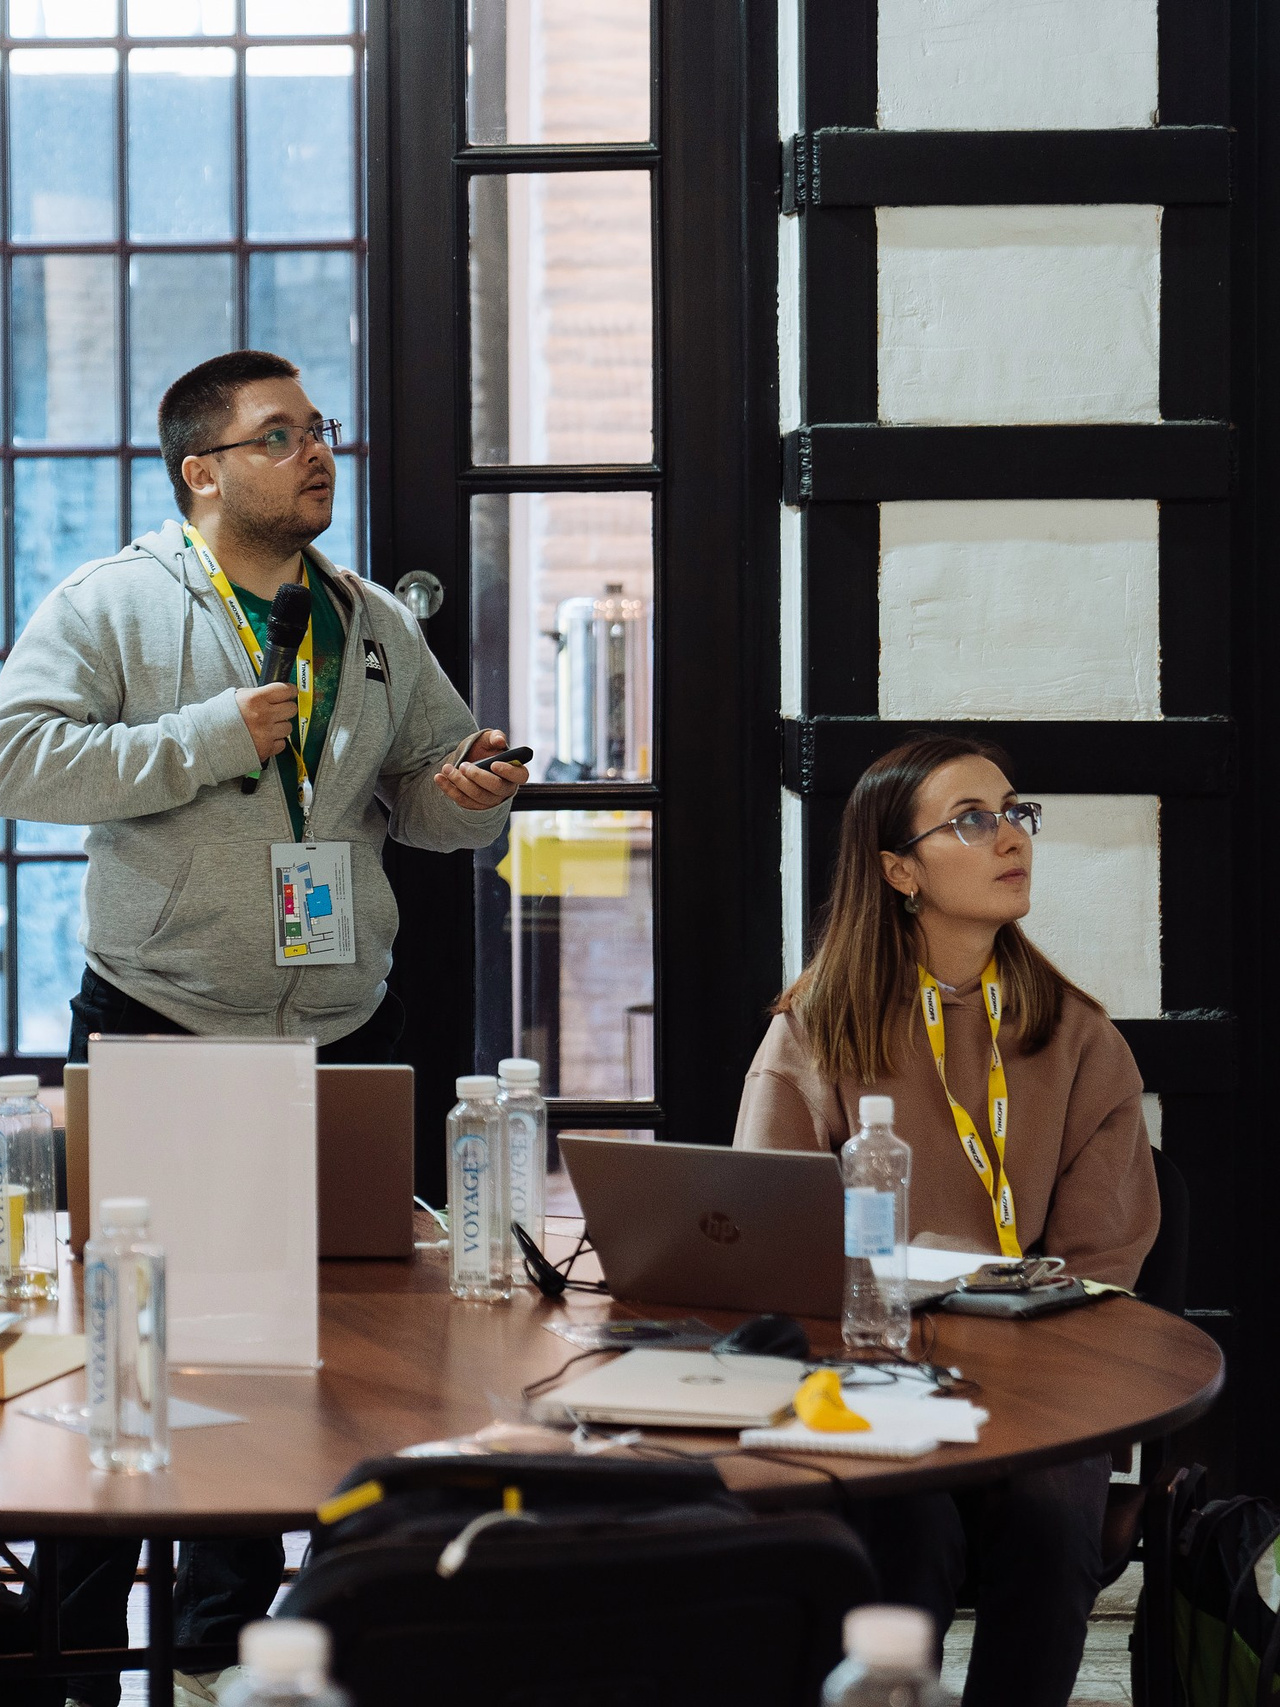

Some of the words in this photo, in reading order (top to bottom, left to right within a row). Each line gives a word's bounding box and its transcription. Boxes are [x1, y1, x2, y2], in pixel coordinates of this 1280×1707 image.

[202, 549, 216, 573] TINKOFF
[228, 599, 244, 626] TINKOFF
[926, 990, 936, 1021] TINKOFF
[990, 986, 998, 1015] TINKOFF
[967, 1139, 985, 1169] TINKOFF
[462, 1160, 479, 1255] VOYAGE
